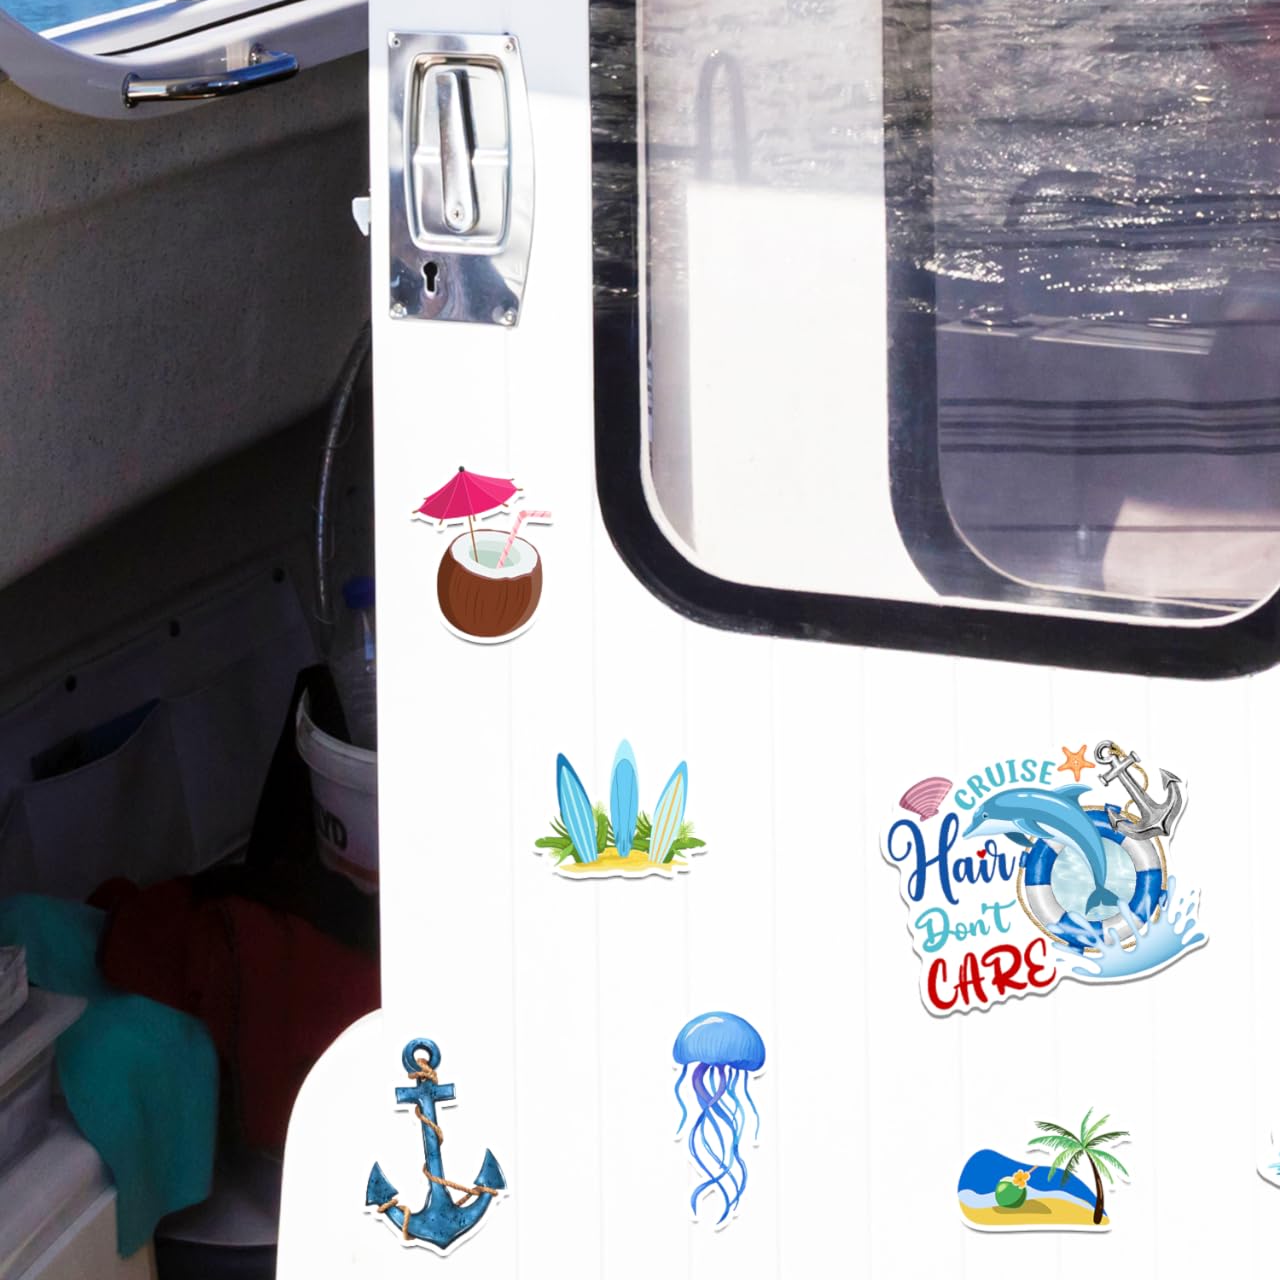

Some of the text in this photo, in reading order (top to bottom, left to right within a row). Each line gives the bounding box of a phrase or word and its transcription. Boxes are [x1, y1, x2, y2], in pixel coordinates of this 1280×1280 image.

[954, 759, 1056, 811] CRUISE
[887, 812, 1016, 905] Hair
[927, 937, 1056, 1009] CARE
